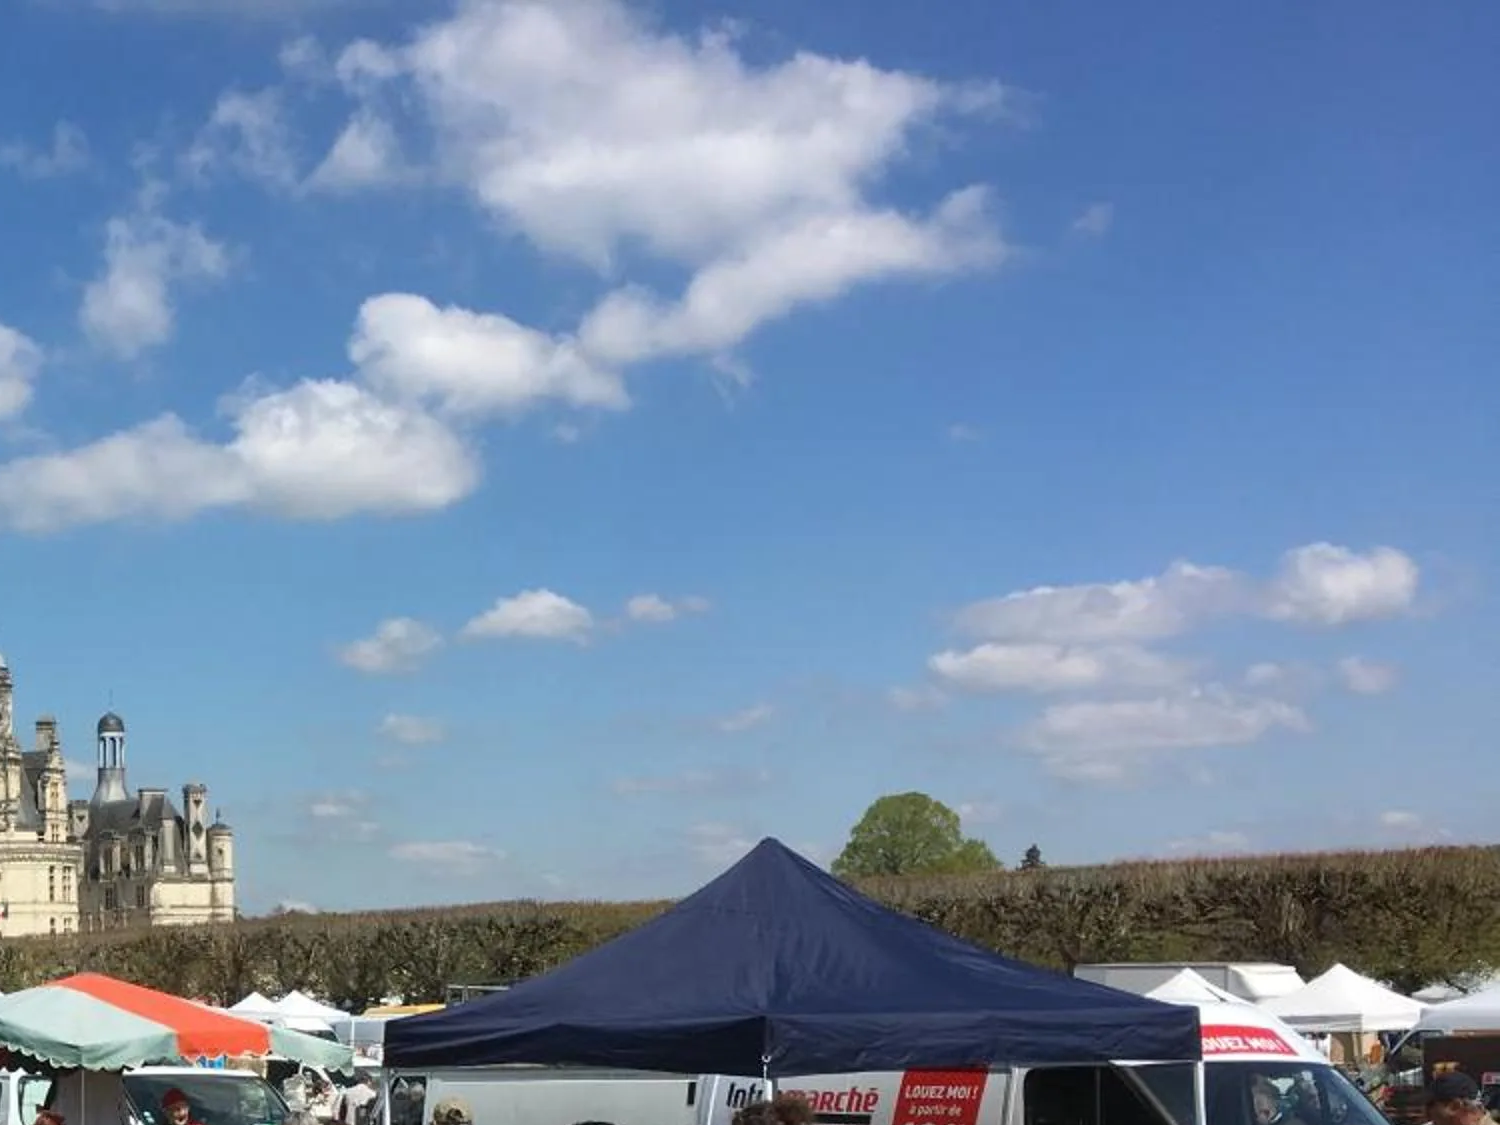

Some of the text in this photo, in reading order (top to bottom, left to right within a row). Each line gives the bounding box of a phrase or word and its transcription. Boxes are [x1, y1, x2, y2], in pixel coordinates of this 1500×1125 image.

[1200, 1036, 1250, 1052] OUEZ
[726, 1081, 879, 1113] Intarché
[904, 1084, 945, 1100] LOUEZ
